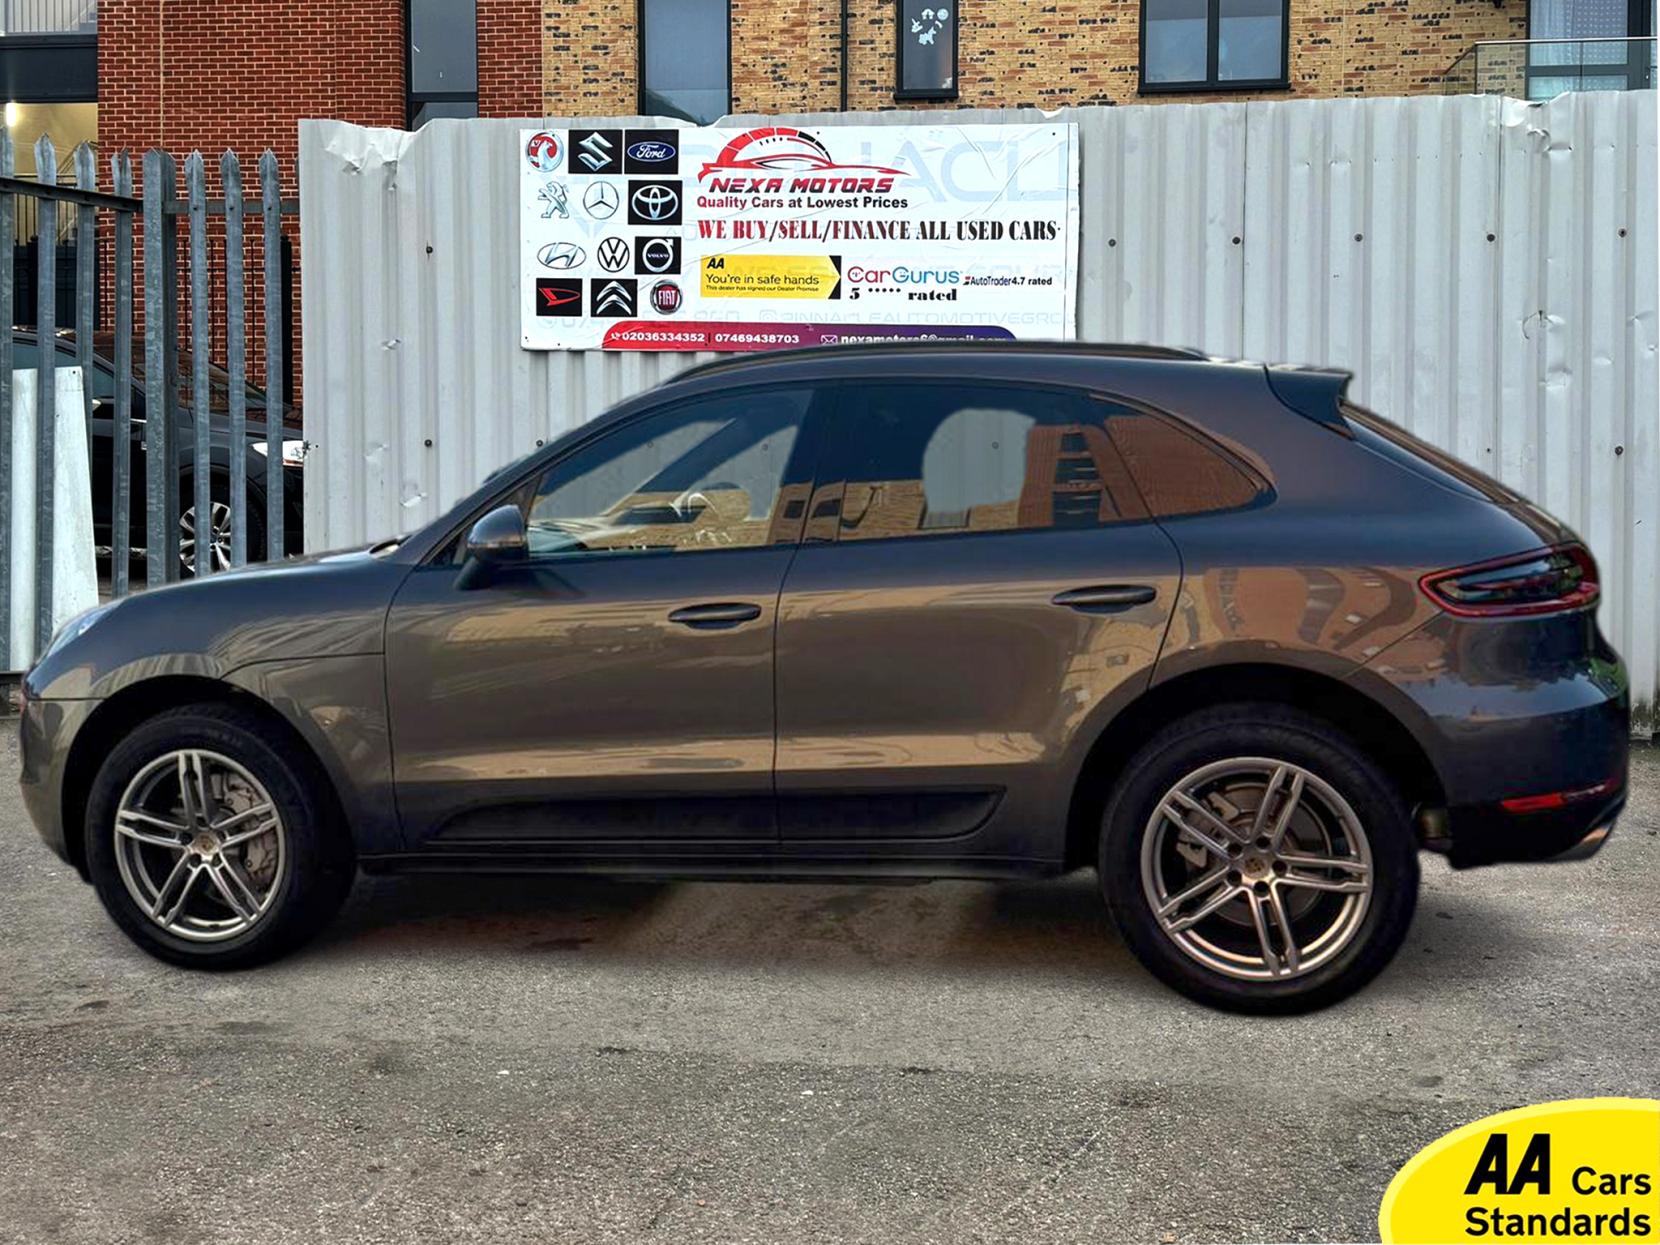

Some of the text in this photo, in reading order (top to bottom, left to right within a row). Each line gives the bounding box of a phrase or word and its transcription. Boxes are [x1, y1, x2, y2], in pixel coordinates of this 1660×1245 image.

[636, 144, 667, 158] Ford
[709, 178, 894, 193] NEXA MOTORS
[697, 196, 908, 210] Quality Cars at Lowest Prices
[697, 220, 1057, 243] WE BUY/SELL/FINANCE ALL USED CARS
[706, 257, 725, 269] AA
[705, 273, 820, 285] You're in safe hands
[847, 266, 960, 284] CarGurus
[1028, 277, 1052, 285] rated
[658, 290, 677, 306] FIAT
[849, 287, 957, 301] 5 rated
[622, 332, 800, 344] 02036334352 07469438703
